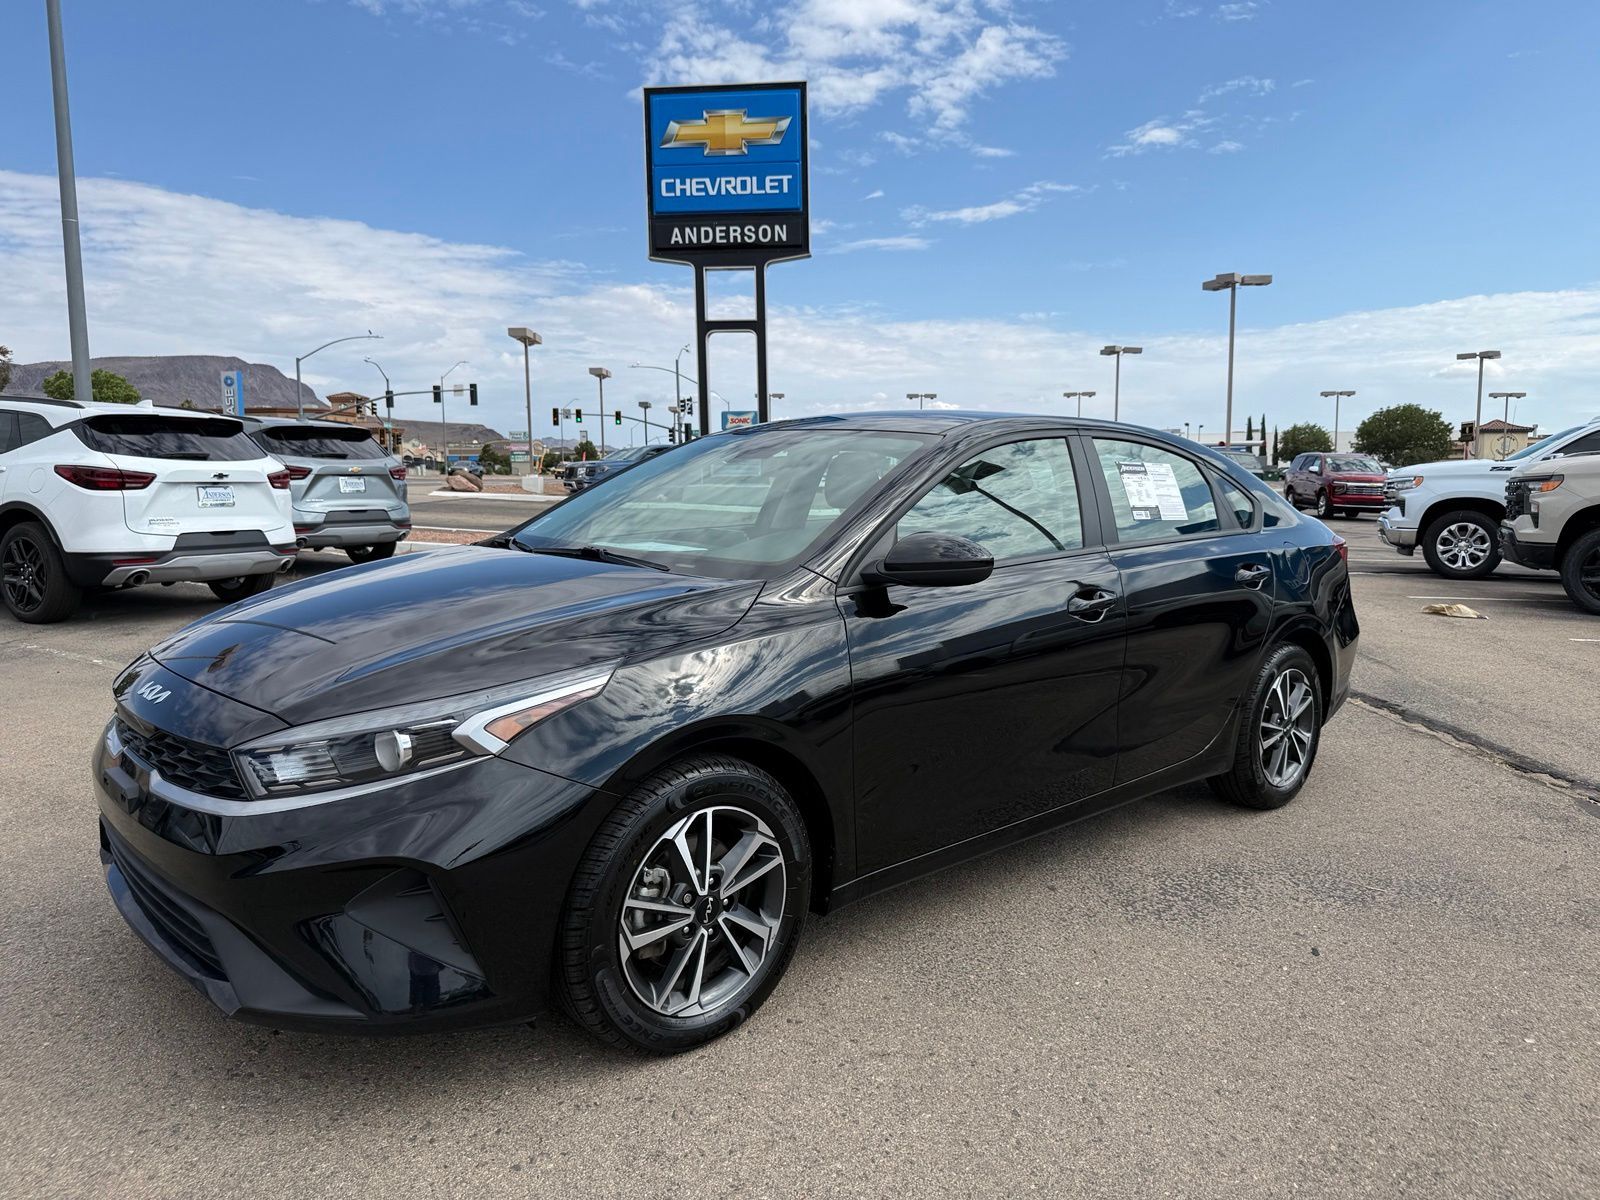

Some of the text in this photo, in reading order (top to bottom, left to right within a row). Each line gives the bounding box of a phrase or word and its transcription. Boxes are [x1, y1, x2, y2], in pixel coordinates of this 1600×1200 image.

[661, 175, 792, 197] CHEVROLET
[671, 224, 787, 244] ANDERSON
[225, 389, 235, 416] ASE
